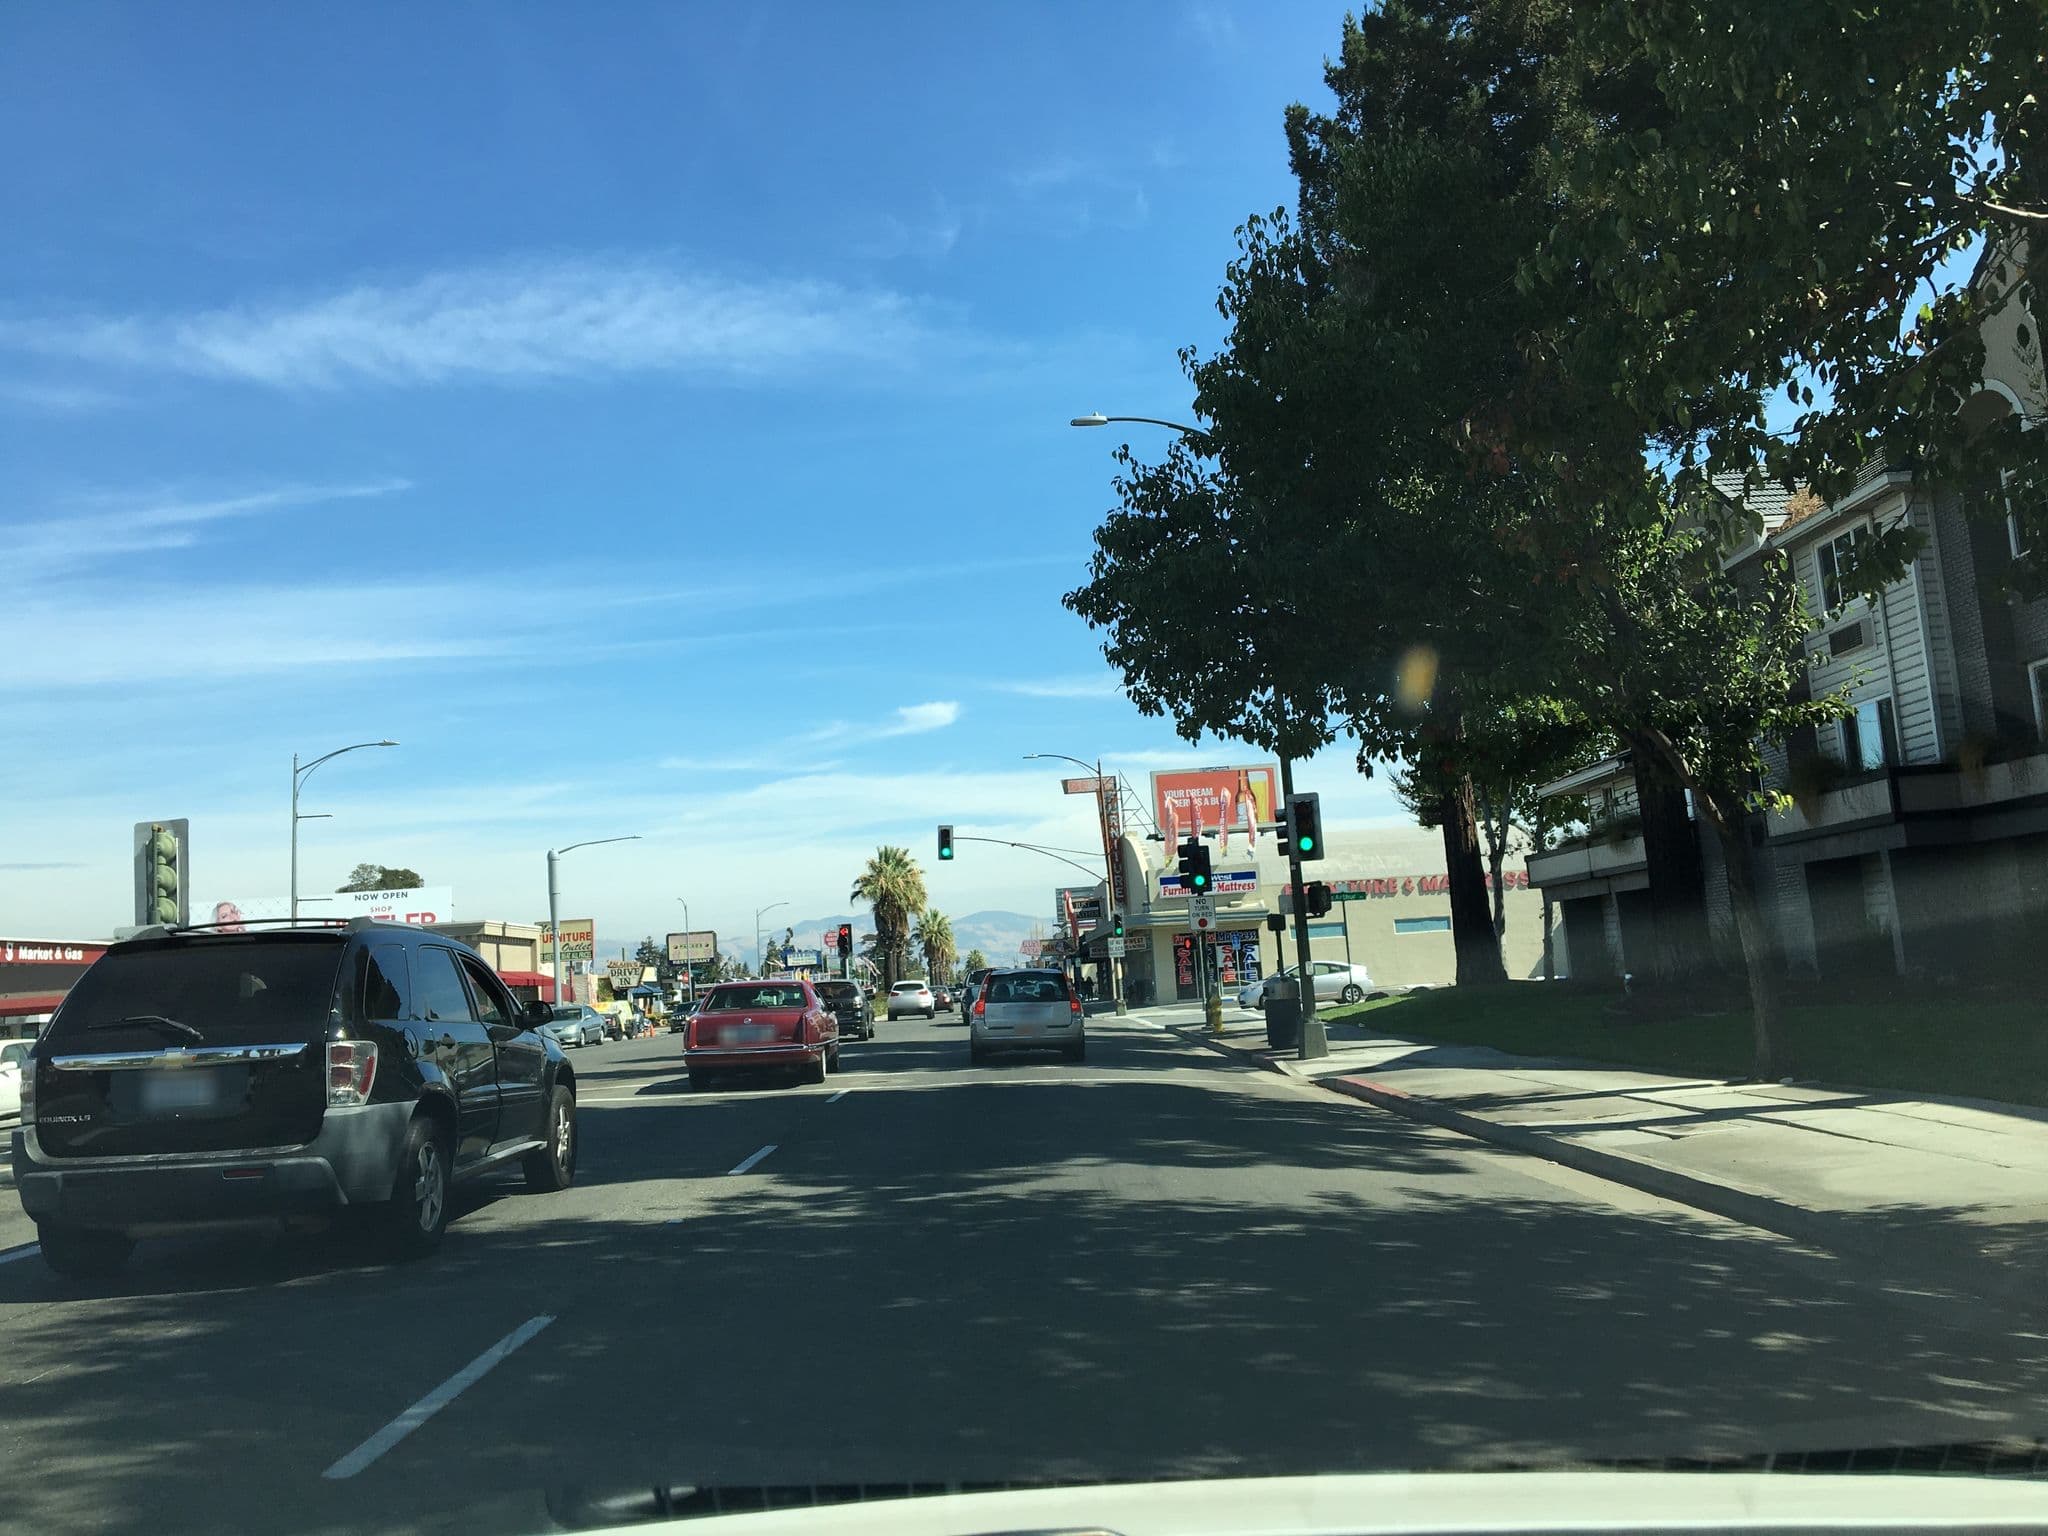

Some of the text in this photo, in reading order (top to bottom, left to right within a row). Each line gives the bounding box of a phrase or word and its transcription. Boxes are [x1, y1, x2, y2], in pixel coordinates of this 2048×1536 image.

[1163, 787, 1213, 800] YOUR DREAM
[1216, 881, 1255, 893] Mattress
[354, 891, 408, 902] NOW OPEN
[369, 905, 392, 913] SHOP
[18, 945, 53, 961] Market
[54, 946, 62, 961] &
[64, 947, 83, 961] Gas
[561, 943, 592, 952] Outlet
[1177, 947, 1193, 985] SALE
[1222, 944, 1237, 983] SALE
[1242, 943, 1259, 981] SALE
[610, 967, 640, 977] DRIVE
[619, 977, 631, 986] IN
